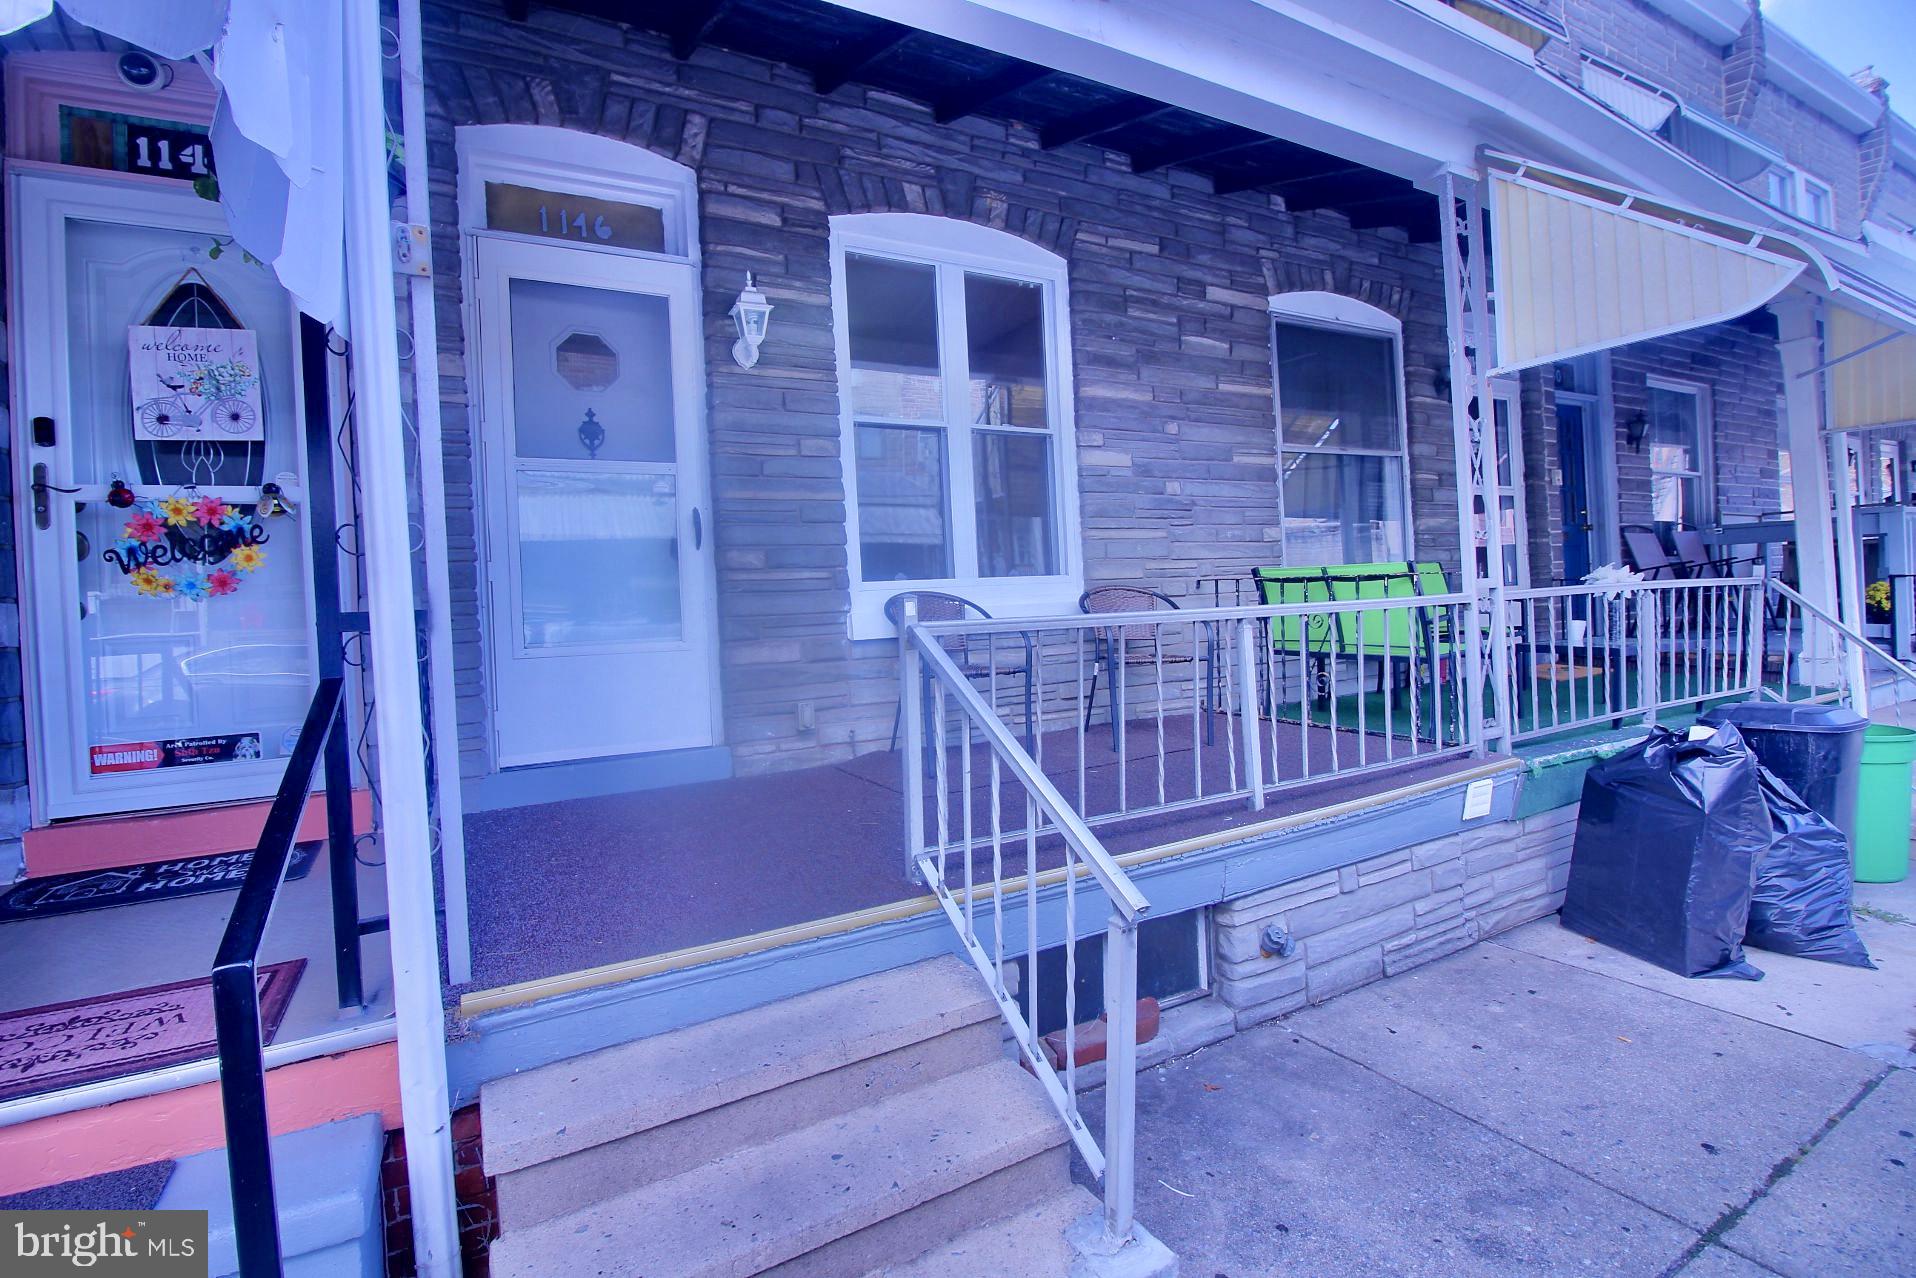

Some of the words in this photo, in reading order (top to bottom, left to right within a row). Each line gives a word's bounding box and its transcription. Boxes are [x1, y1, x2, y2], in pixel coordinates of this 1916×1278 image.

[136, 136, 209, 175] 114
[539, 205, 613, 240] 1146
[141, 329, 224, 352] welcome
[166, 352, 208, 363] HOME
[103, 523, 270, 576] Welcome
[184, 739, 216, 747] Patrolled
[93, 749, 158, 767] WARNING!
[155, 852, 255, 873] HOME
[135, 870, 248, 892] HOME
[0, 1012, 188, 1057] WELCO
